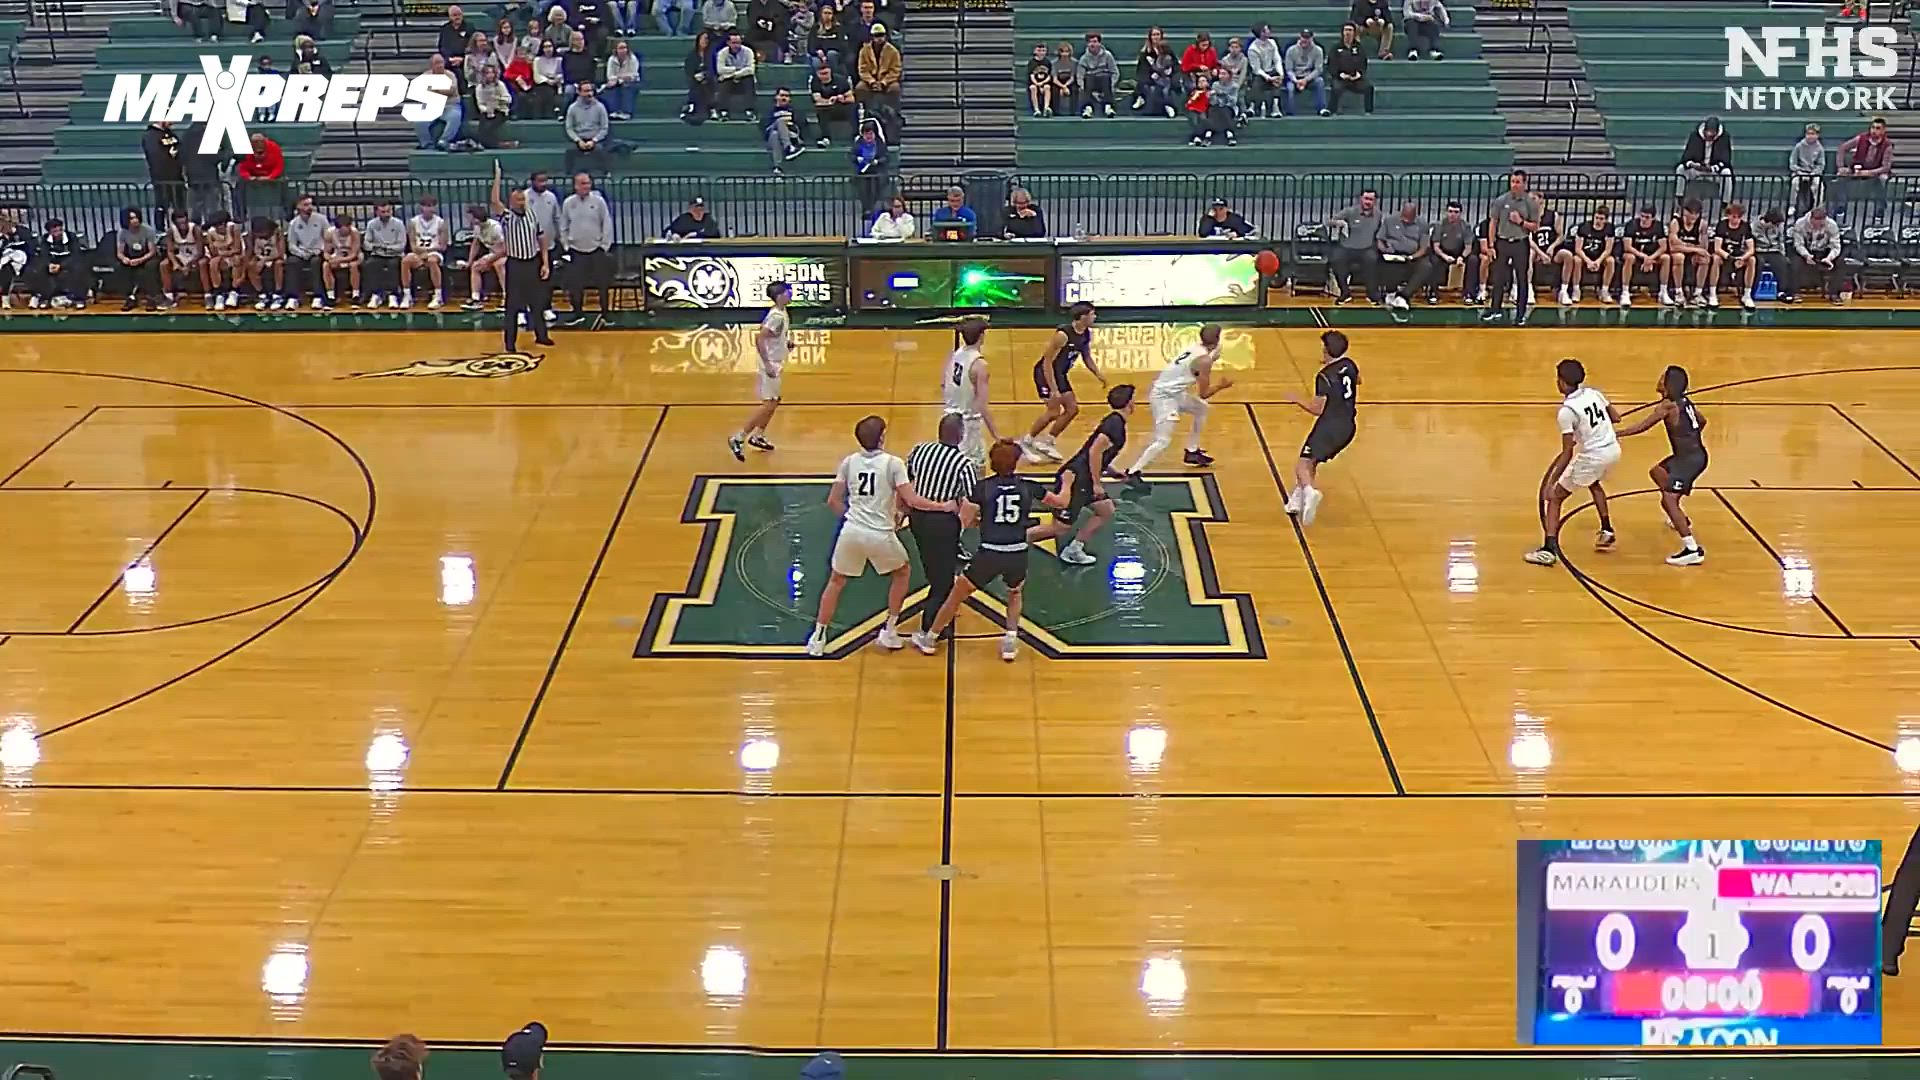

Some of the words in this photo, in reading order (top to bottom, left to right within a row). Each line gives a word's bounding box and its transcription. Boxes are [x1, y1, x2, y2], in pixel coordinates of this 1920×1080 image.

[753, 263, 825, 282] MASON
[1342, 375, 1353, 399] 3
[1584, 402, 1606, 429] 24
[858, 472, 876, 496] 21
[994, 494, 1021, 524] 15
[1553, 874, 1701, 892] MARAUDERS
[1596, 913, 1636, 971] 0
[1705, 933, 1719, 960] 1
[1791, 914, 1830, 971] 0
